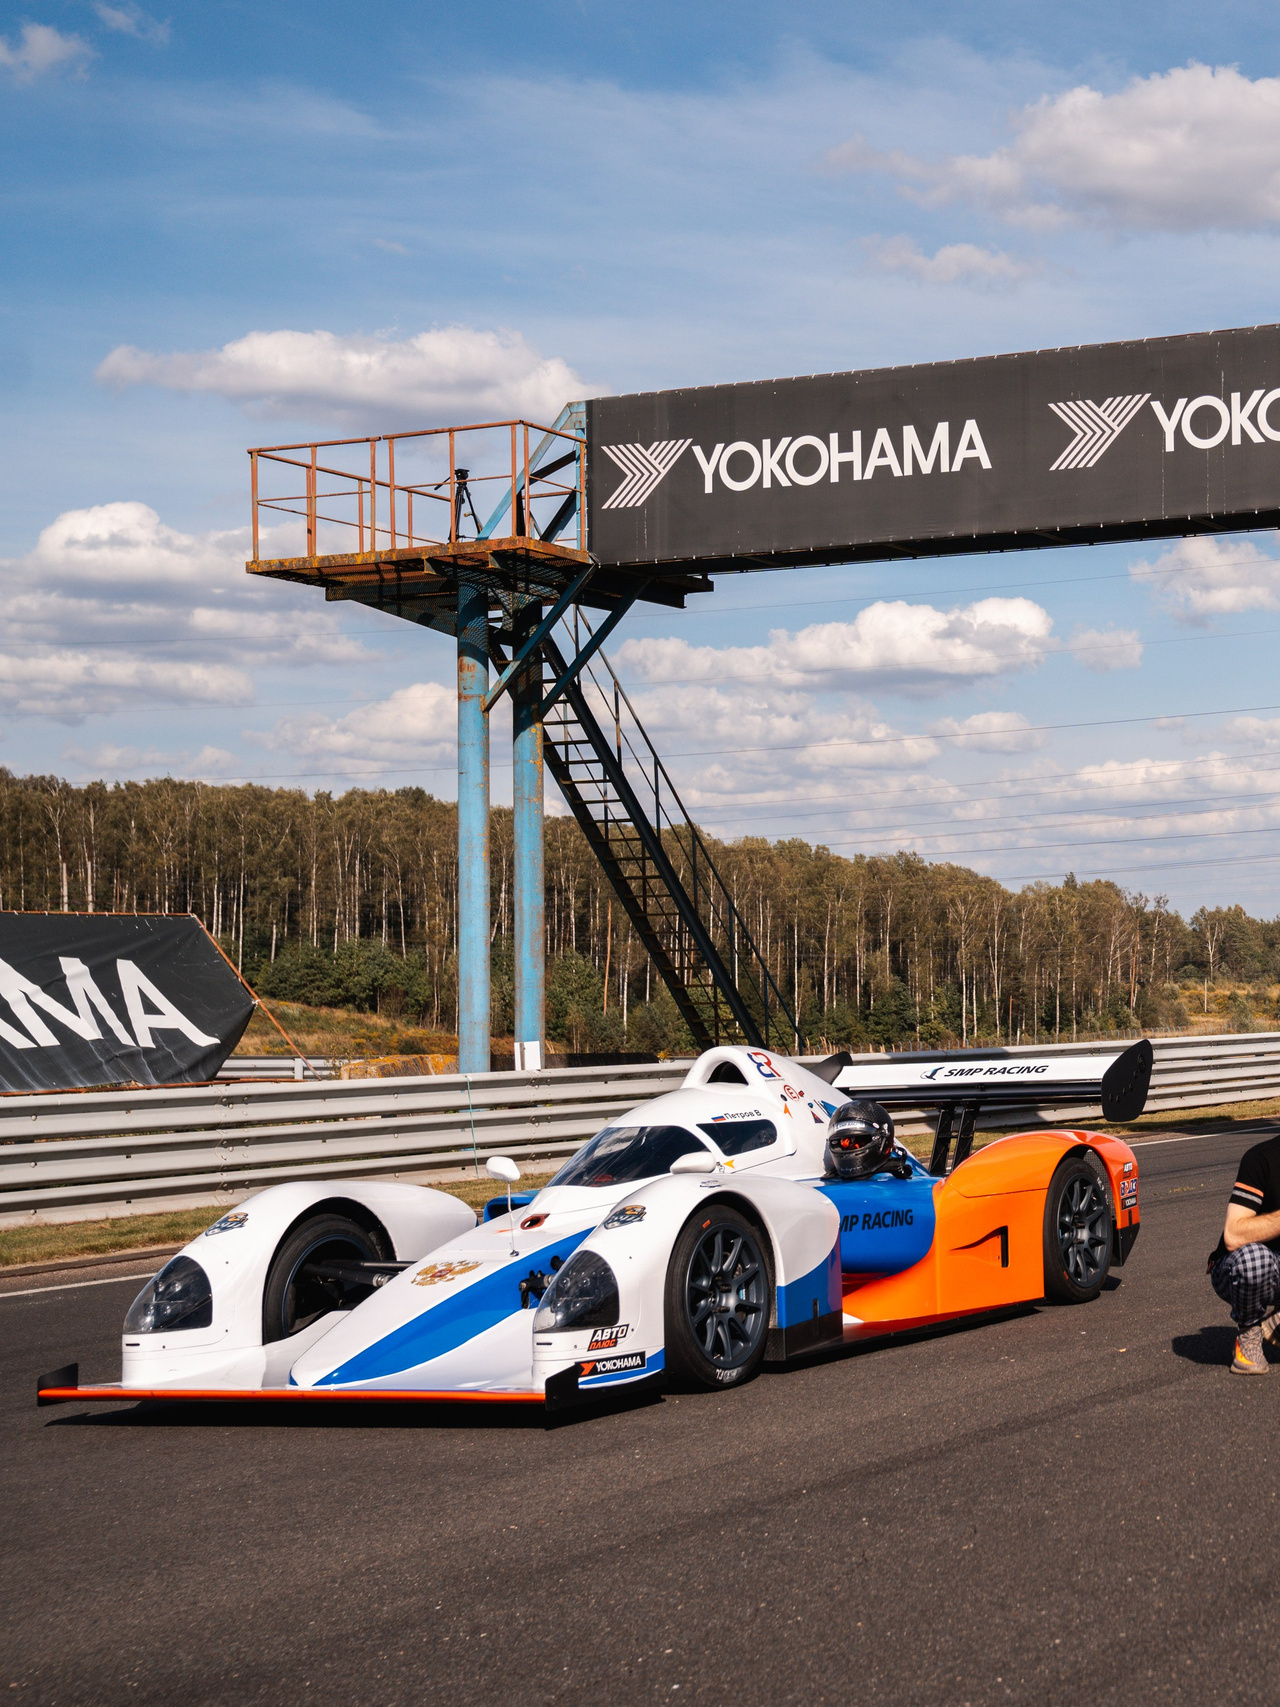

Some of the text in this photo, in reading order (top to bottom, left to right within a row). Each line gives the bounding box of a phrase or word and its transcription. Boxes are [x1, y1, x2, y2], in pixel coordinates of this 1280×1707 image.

[692, 419, 992, 493] YOKOHAMA
[944, 1065, 1049, 1077] SMP RACING
[861, 1209, 914, 1231] RACING
[592, 1326, 627, 1342] АВТО
[589, 1338, 617, 1350] ПЛЮС
[596, 1355, 642, 1372] YOKOHAMA
